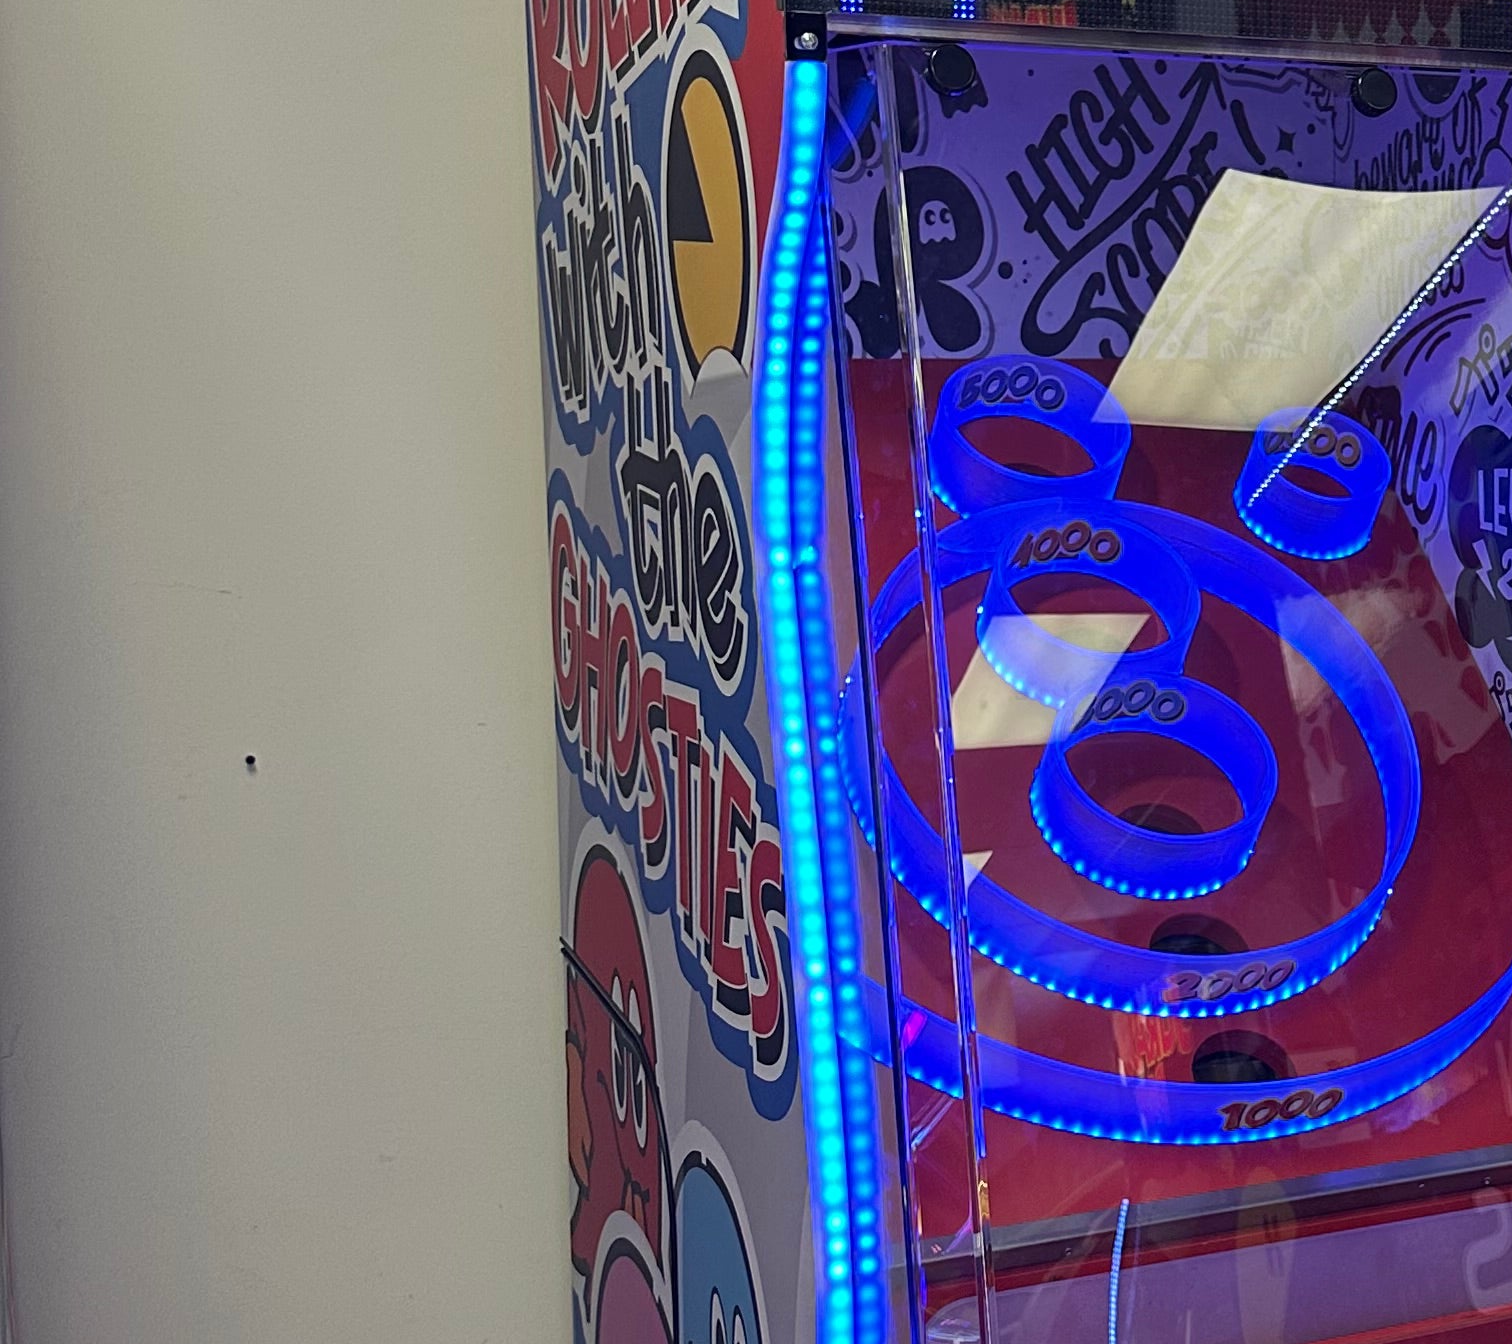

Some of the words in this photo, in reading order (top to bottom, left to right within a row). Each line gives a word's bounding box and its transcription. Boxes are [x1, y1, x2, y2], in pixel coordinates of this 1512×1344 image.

[546, 104, 662, 413] with
[622, 372, 748, 694] the
[959, 364, 1065, 410] 5000
[551, 513, 787, 1066] GHOSTIES
[1162, 959, 1296, 1003] 2000
[1218, 1088, 1344, 1131] 1000
